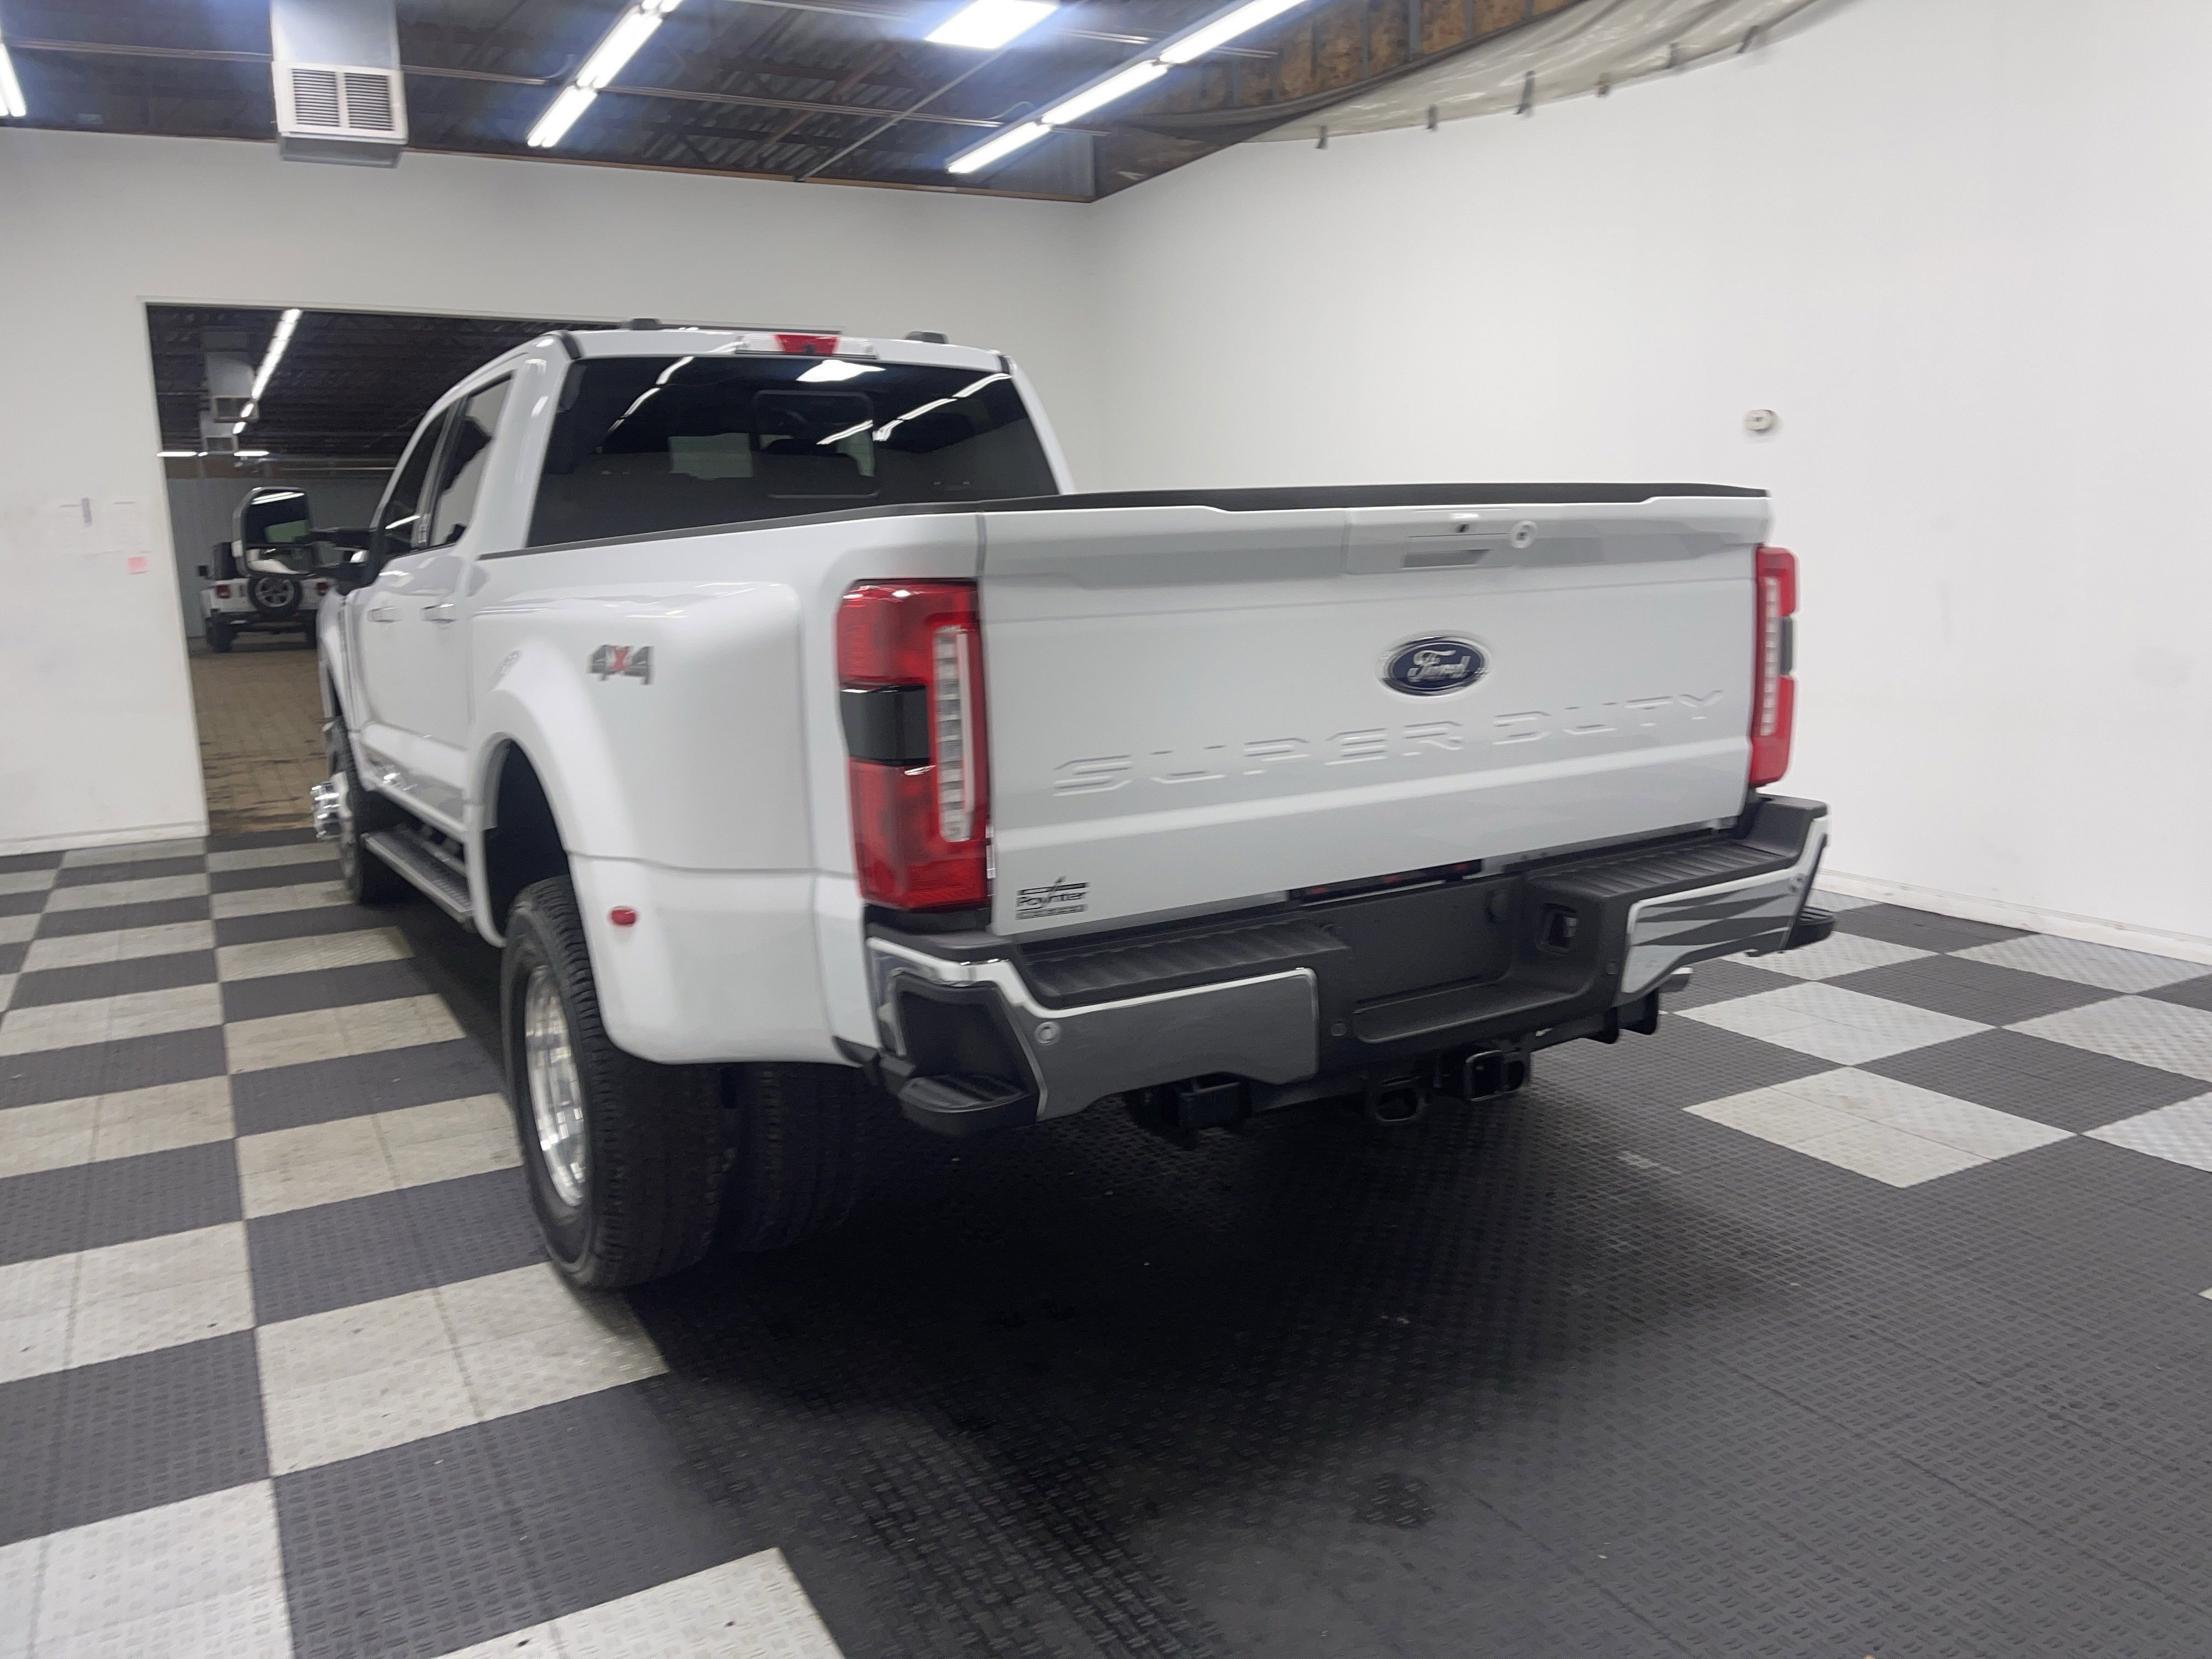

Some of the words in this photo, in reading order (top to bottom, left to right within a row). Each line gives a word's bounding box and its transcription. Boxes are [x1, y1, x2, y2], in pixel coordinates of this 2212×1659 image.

[1407, 650, 1471, 682] Ford
[1053, 720, 1464, 797] SUPER
[1492, 689, 1725, 746] DUTY
